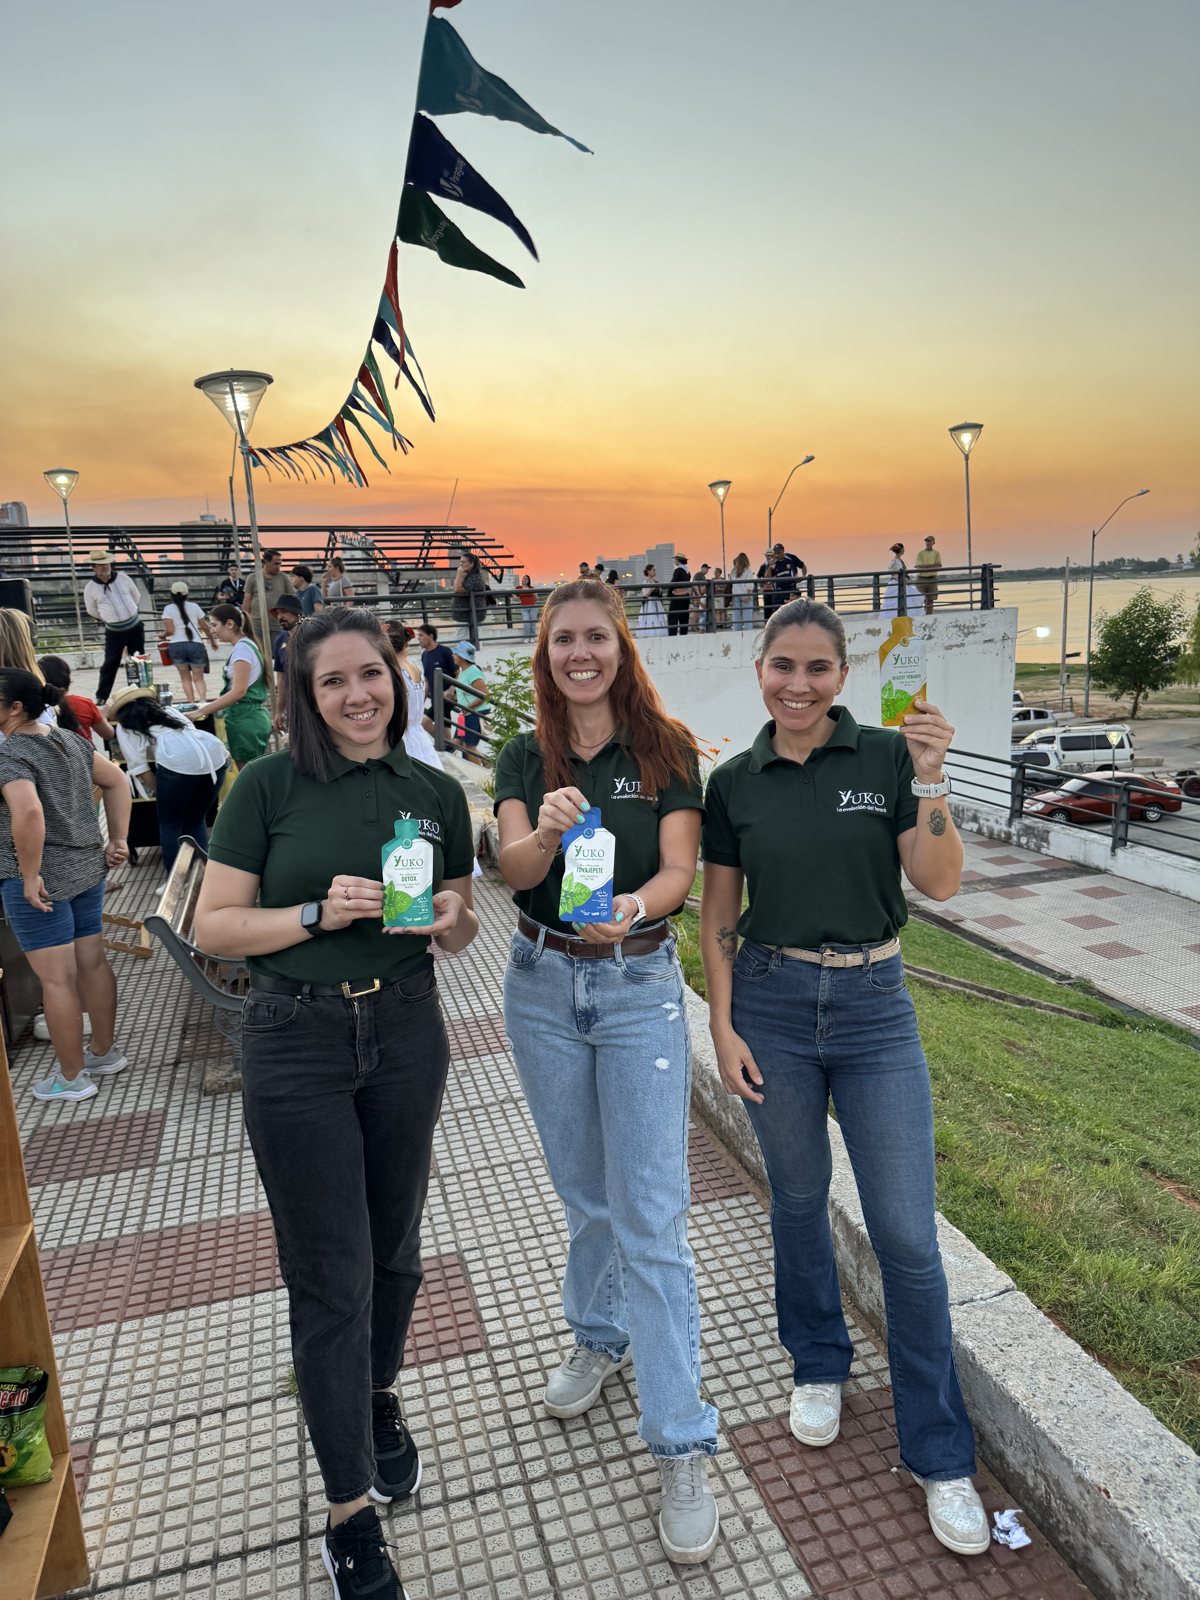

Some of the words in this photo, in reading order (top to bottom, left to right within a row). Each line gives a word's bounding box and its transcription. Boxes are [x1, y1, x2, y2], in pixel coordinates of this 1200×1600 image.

[892, 653, 920, 666] YUKO
[613, 776, 645, 794] YUK
[838, 789, 885, 806] YUKO
[575, 845, 605, 858] YUKO
[393, 855, 424, 868] YUKO
